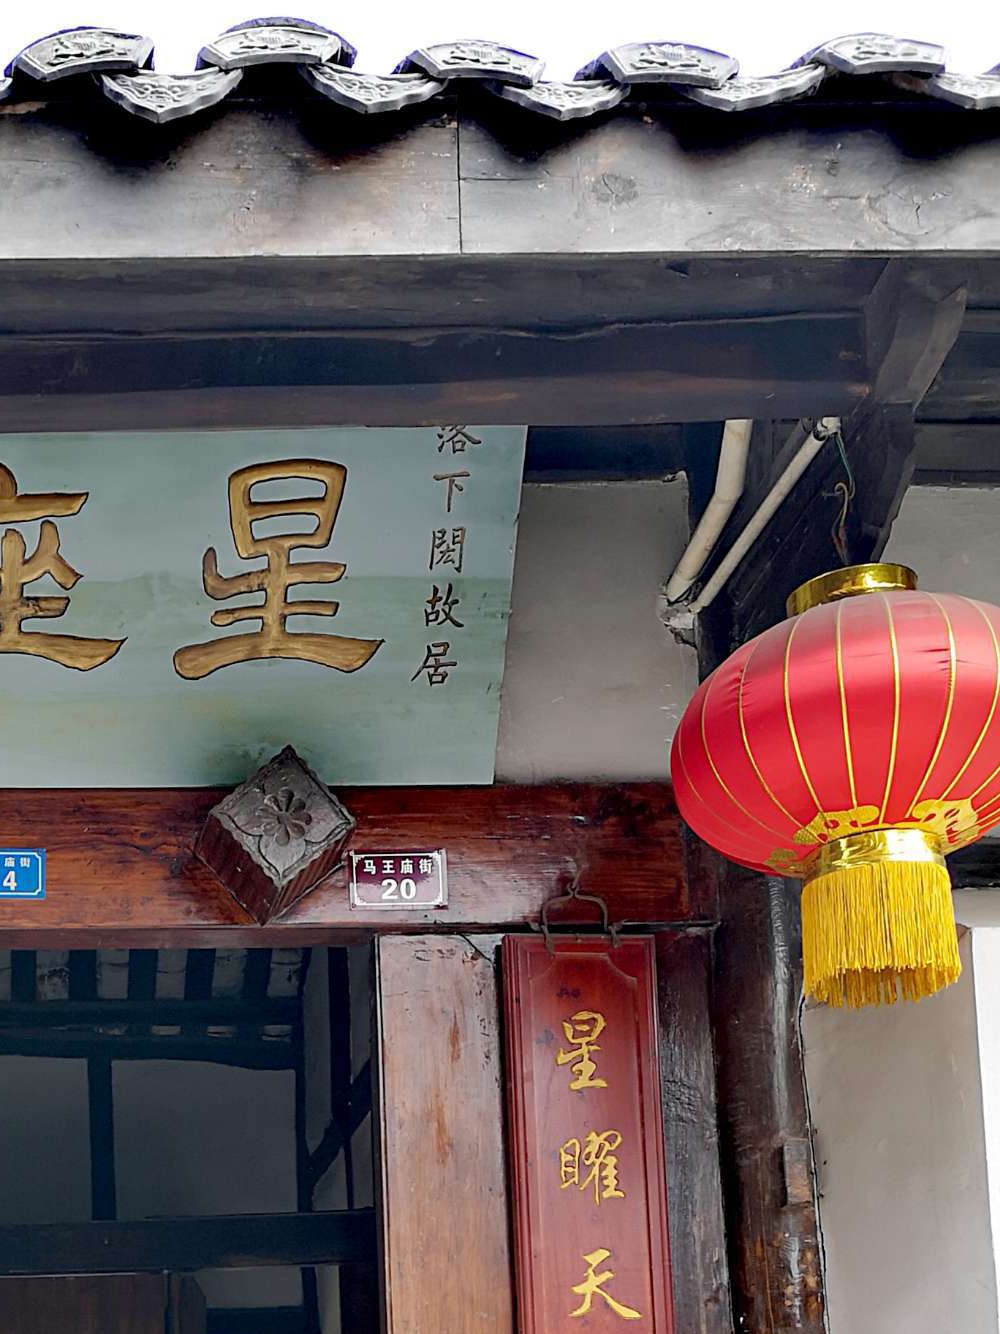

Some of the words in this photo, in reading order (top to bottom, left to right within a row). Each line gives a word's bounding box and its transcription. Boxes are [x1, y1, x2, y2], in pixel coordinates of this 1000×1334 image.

[363, 858, 433, 875] 马王庙街
[381, 878, 416, 900] 20
